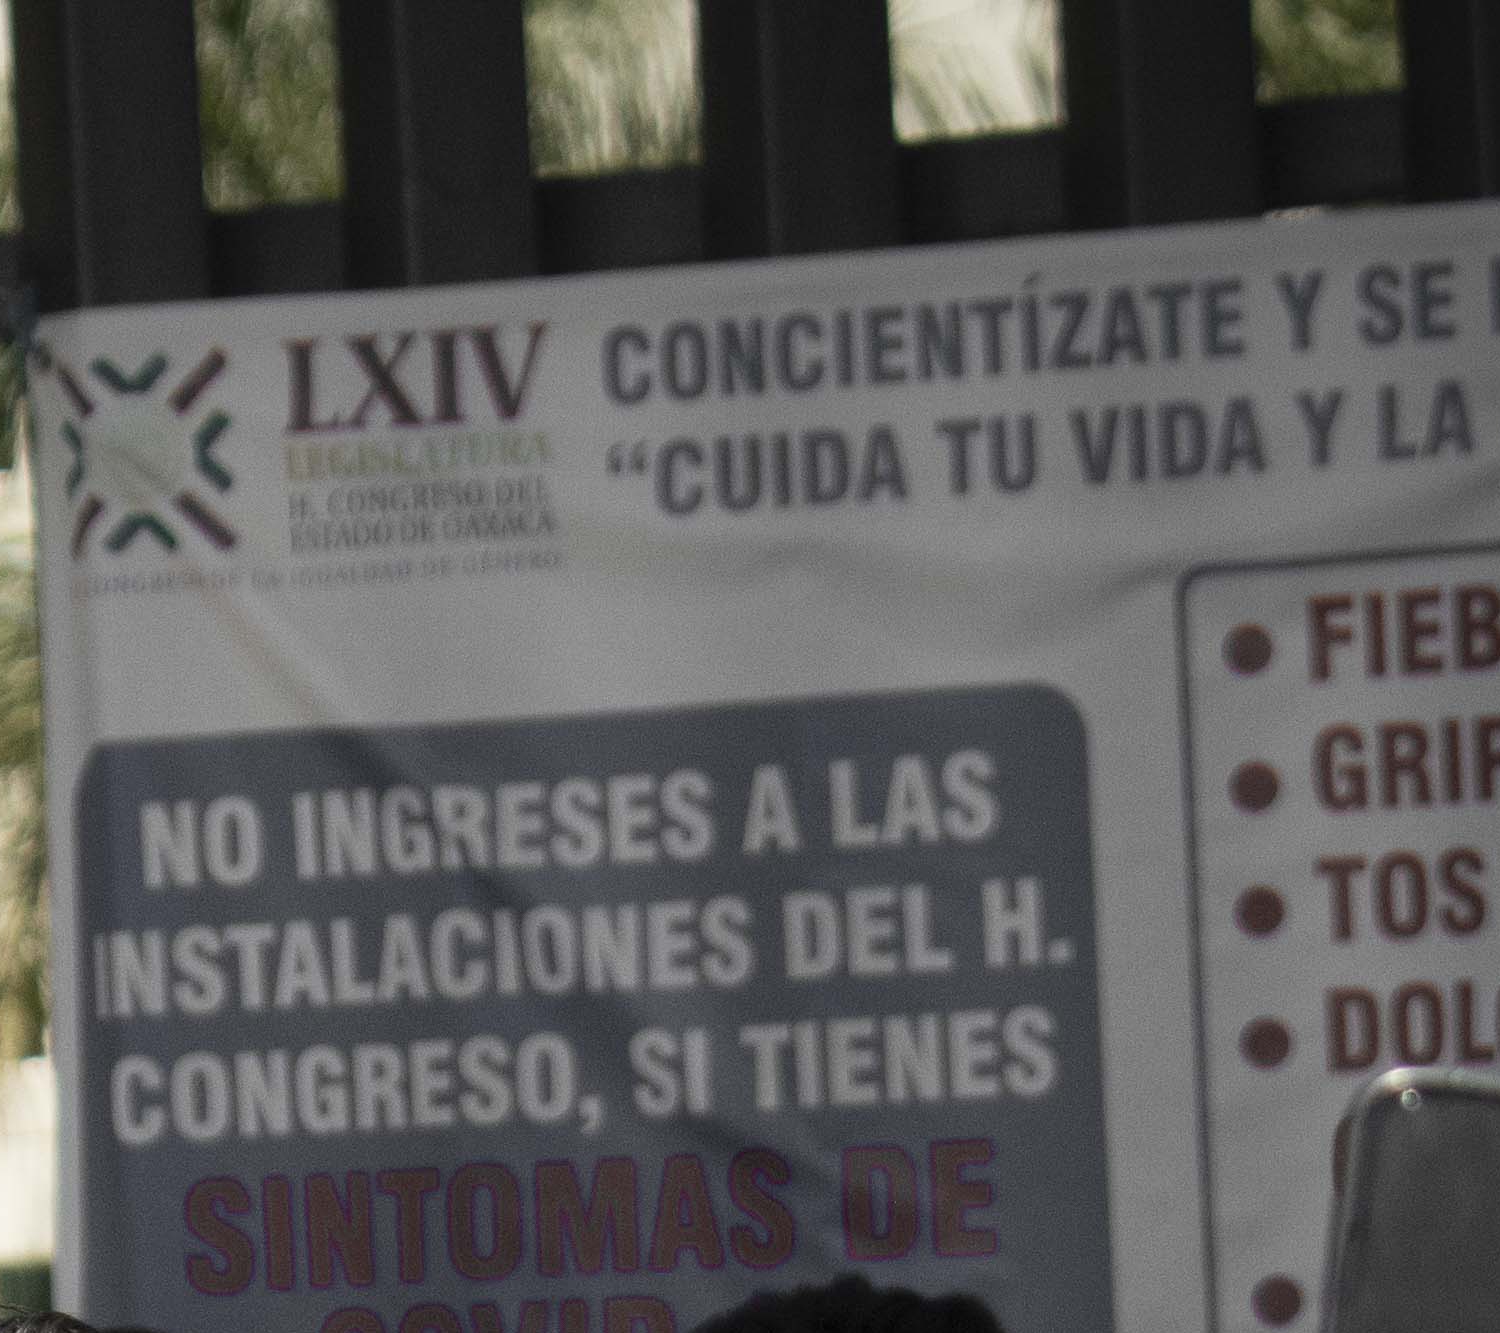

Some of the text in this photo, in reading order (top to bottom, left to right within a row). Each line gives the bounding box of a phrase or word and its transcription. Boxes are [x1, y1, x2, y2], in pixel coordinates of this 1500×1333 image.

[281, 322, 549, 434] LXIV
[603, 276, 1246, 406] CONCIENTÍZATE
[1276, 272, 1326, 350] Y
[1358, 261, 1456, 345] SE
[937, 412, 1036, 492] TU
[1072, 396, 1267, 485] VIDA
[1298, 389, 1347, 467] Y
[1377, 378, 1475, 459] LA
[140, 750, 997, 889] NO INGRESES A LAS
[95, 878, 1074, 1020] INSTALACIONES DEL H.
[1316, 848, 1484, 944] TOS
[110, 1007, 1058, 1147] CONGRESO, SI TIENES
[185, 1138, 997, 1295] SINTOMAS DE
